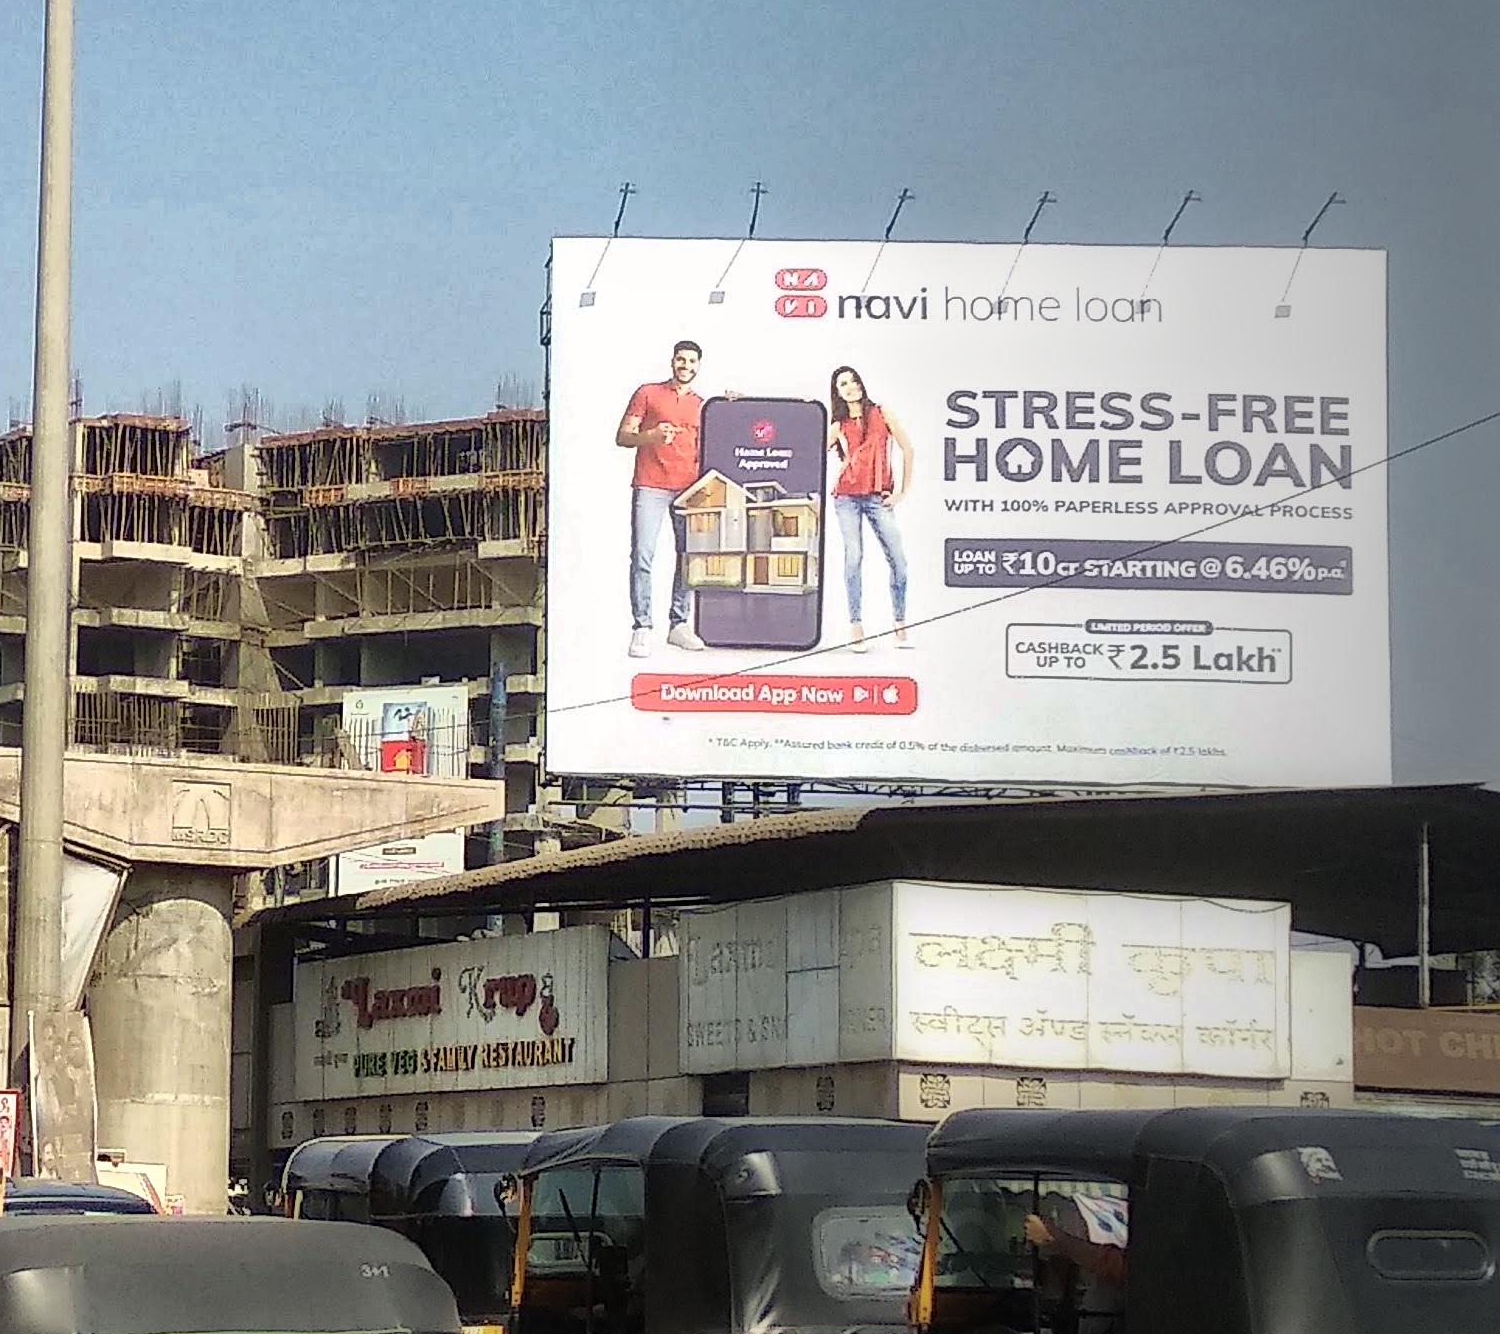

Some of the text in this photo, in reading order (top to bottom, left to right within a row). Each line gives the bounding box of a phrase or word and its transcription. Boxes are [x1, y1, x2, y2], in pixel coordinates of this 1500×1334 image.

[838, 286, 1162, 322] navi home loan
[945, 390, 1350, 436] STRESS-FREE
[944, 437, 1352, 489] HOME LOAN
[944, 499, 1353, 520] WITH 100% PAPERLESS APPROVAL PROCESS
[953, 550, 996, 563] LOAN
[954, 563, 997, 575] UP TO
[1083, 559, 1197, 578] STARTING
[1090, 622, 1132, 633] LIMITED
[1133, 622, 1172, 633] PERIOD
[1015, 641, 1104, 655] CASHBACK
[1036, 656, 1086, 668] UP TO
[660, 683, 843, 705] Download App Now
[341, 967, 442, 1030] Laxmi
[353, 1051, 388, 1078] PURE
[481, 1037, 576, 1070] RESTAURANT
